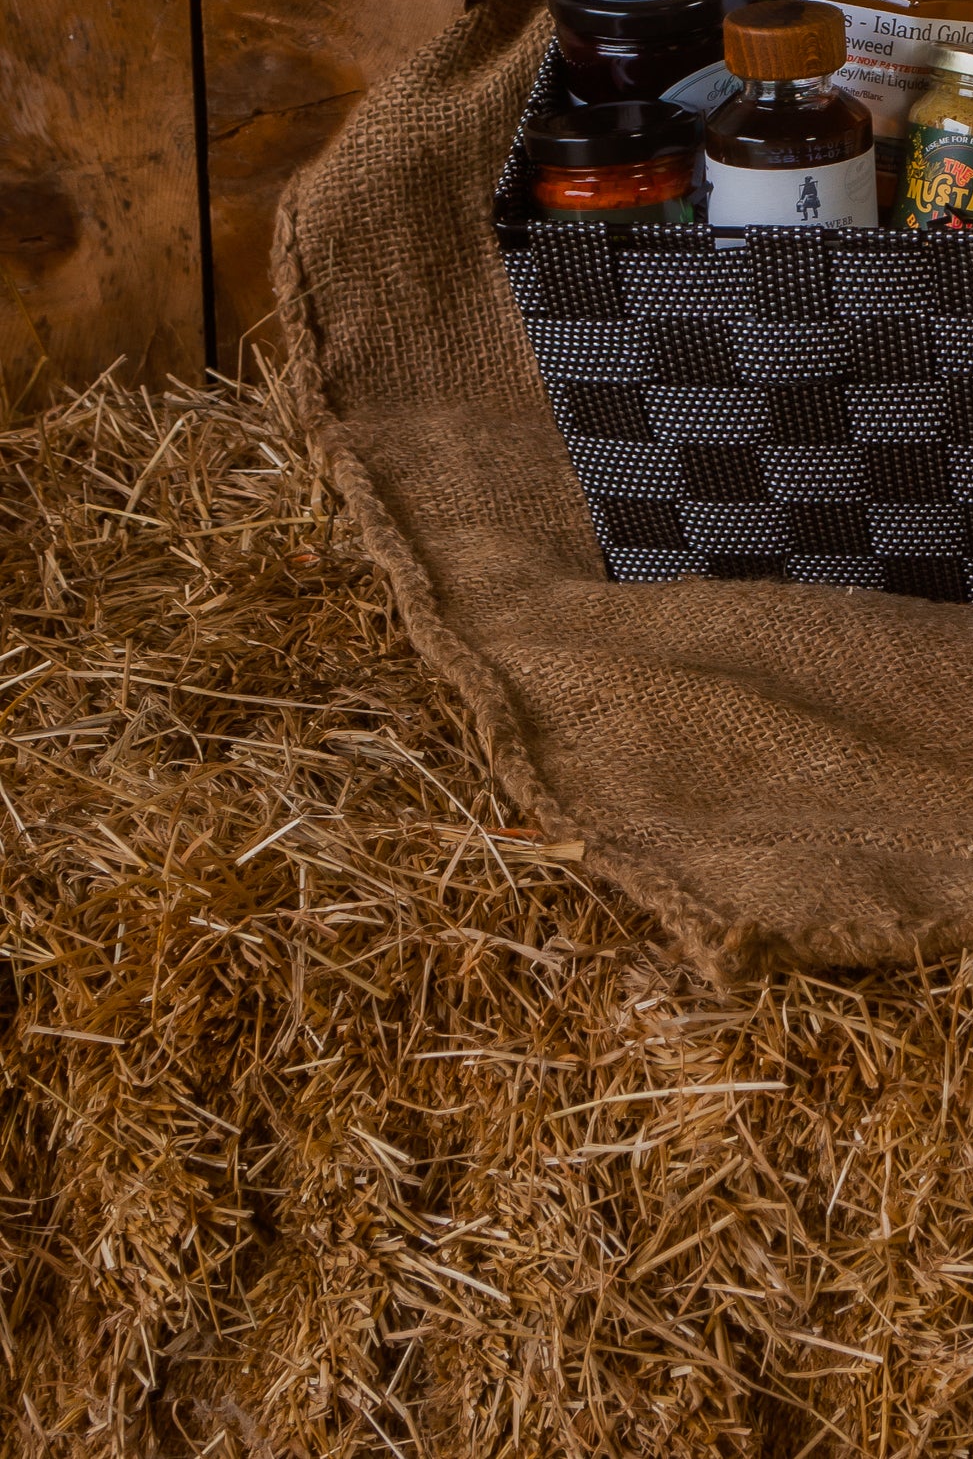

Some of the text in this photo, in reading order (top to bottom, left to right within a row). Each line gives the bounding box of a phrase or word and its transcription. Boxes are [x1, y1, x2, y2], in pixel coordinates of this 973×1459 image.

[873, 15, 933, 41] Island
[846, 36, 893, 56] eweed
[888, 75, 930, 92] Liquide
[925, 142, 939, 152] USE
[939, 136, 950, 145] ME
[951, 135, 969, 143] FOR
[825, 215, 853, 229] WEBB
